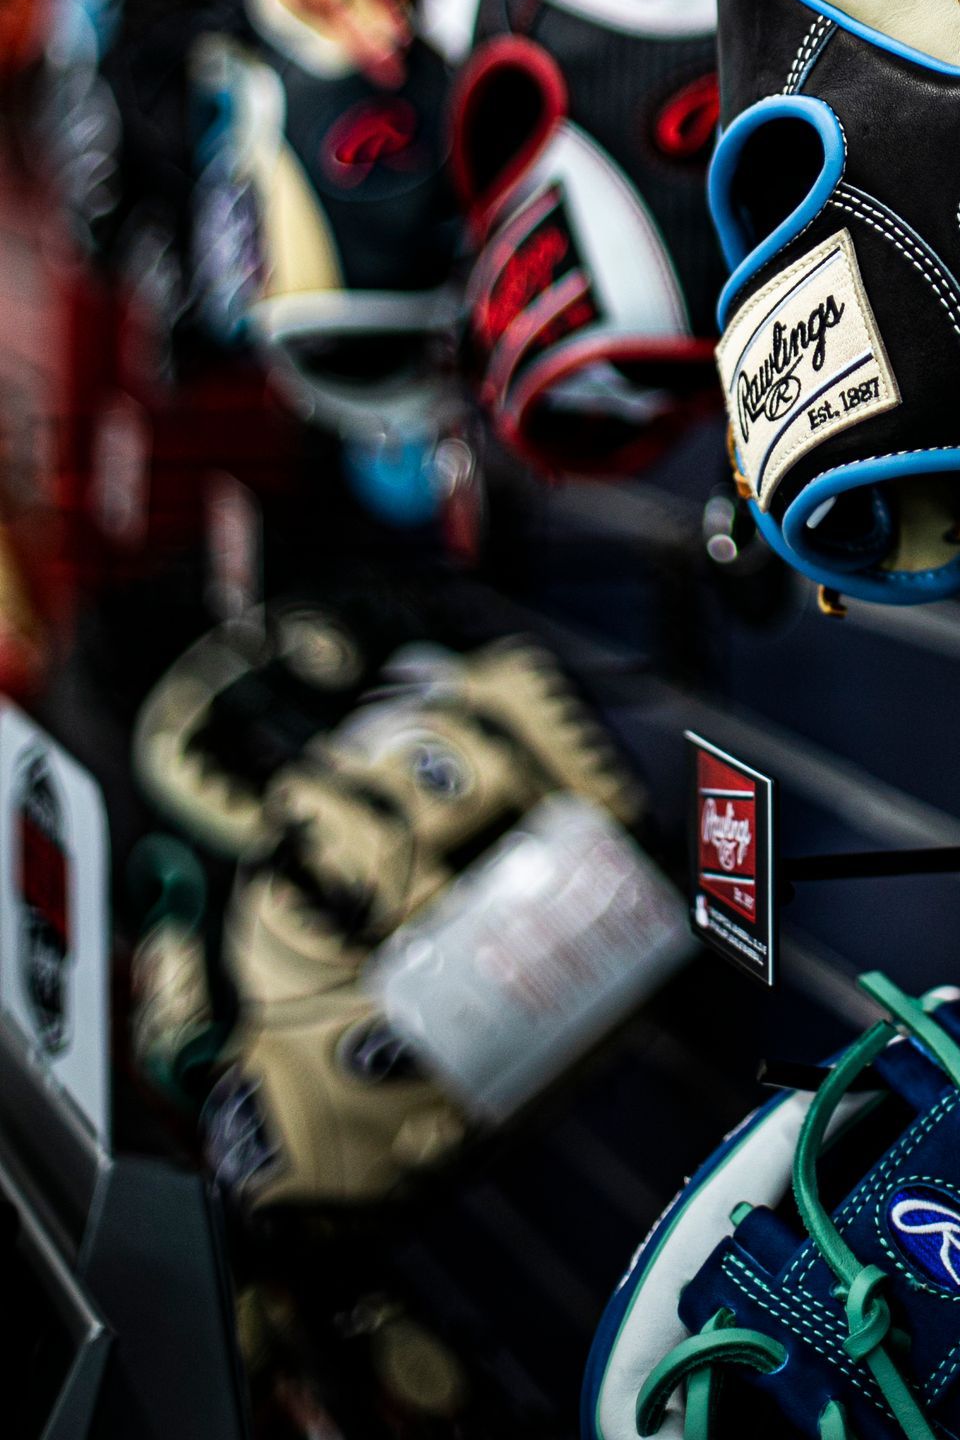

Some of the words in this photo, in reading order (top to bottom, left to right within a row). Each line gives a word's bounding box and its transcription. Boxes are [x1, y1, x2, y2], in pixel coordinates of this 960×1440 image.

[736, 294, 846, 444] Rawlings
[807, 400, 841, 431] Est.
[838, 375, 881, 411] 1887
